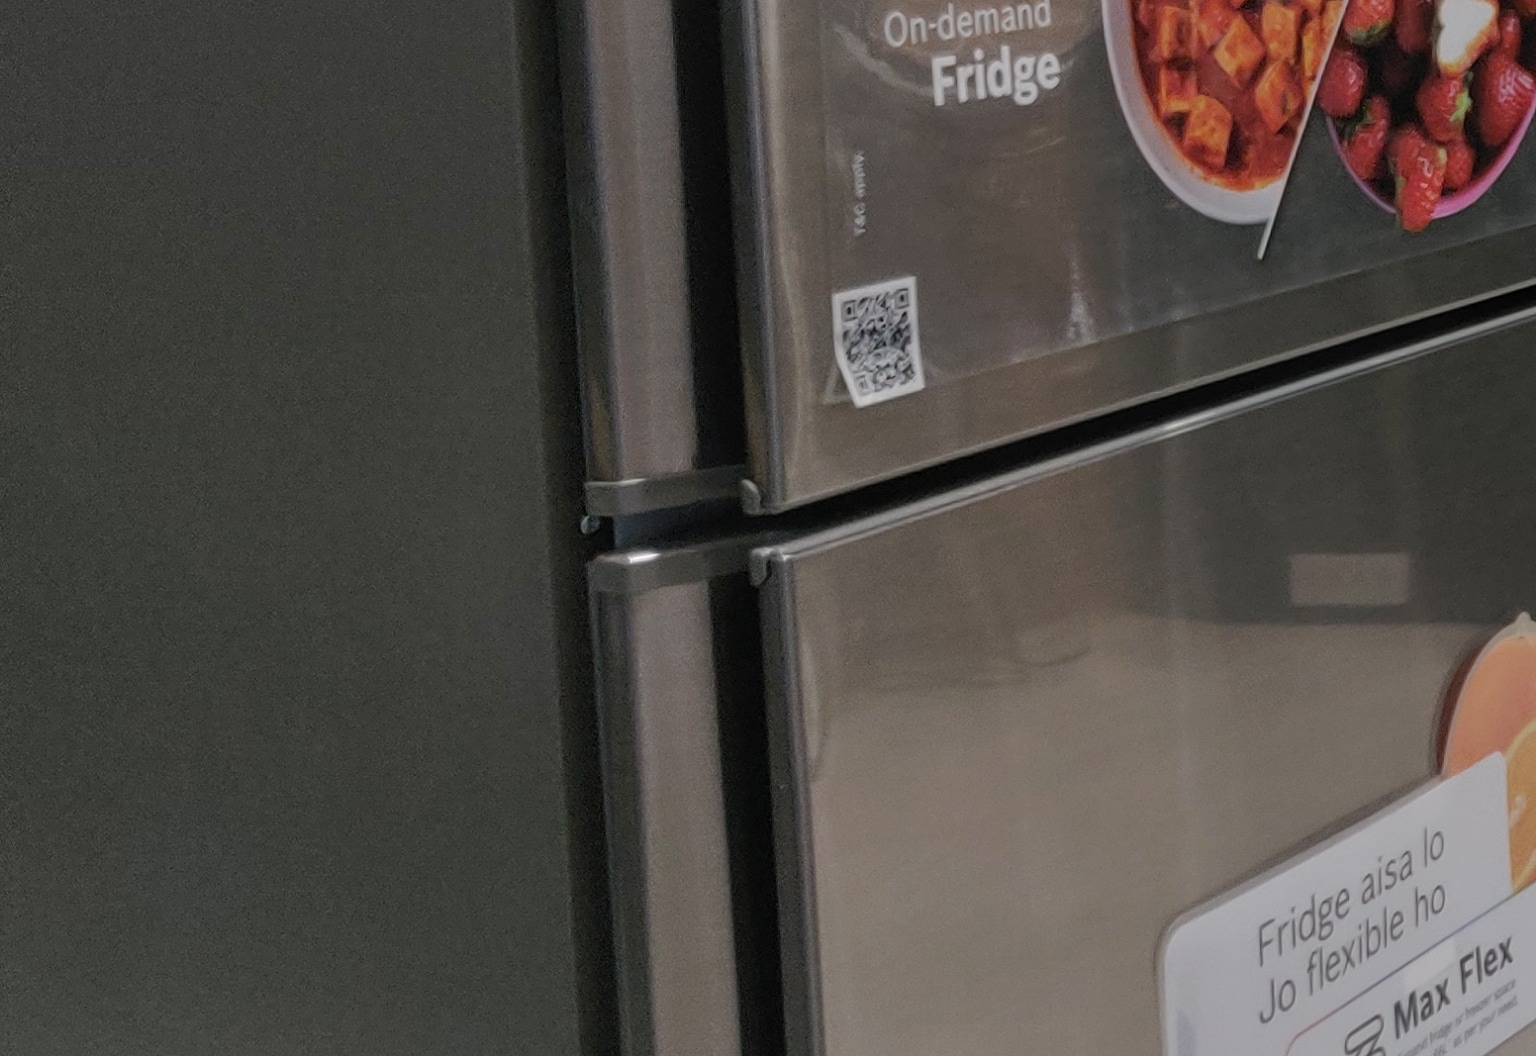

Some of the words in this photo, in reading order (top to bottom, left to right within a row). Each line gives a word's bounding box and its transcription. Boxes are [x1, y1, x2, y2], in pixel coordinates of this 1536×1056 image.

[930, 44, 1062, 108] Fridge
[1257, 887, 1351, 969] Fridge
[1360, 849, 1414, 906] aisa
[1422, 826, 1446, 869] lo
[1258, 977, 1297, 1025] Jo
[1306, 905, 1405, 997] flexible
[1414, 883, 1447, 929] ho
[1393, 976, 1452, 1041] Max
[1458, 935, 1515, 994] Flex
